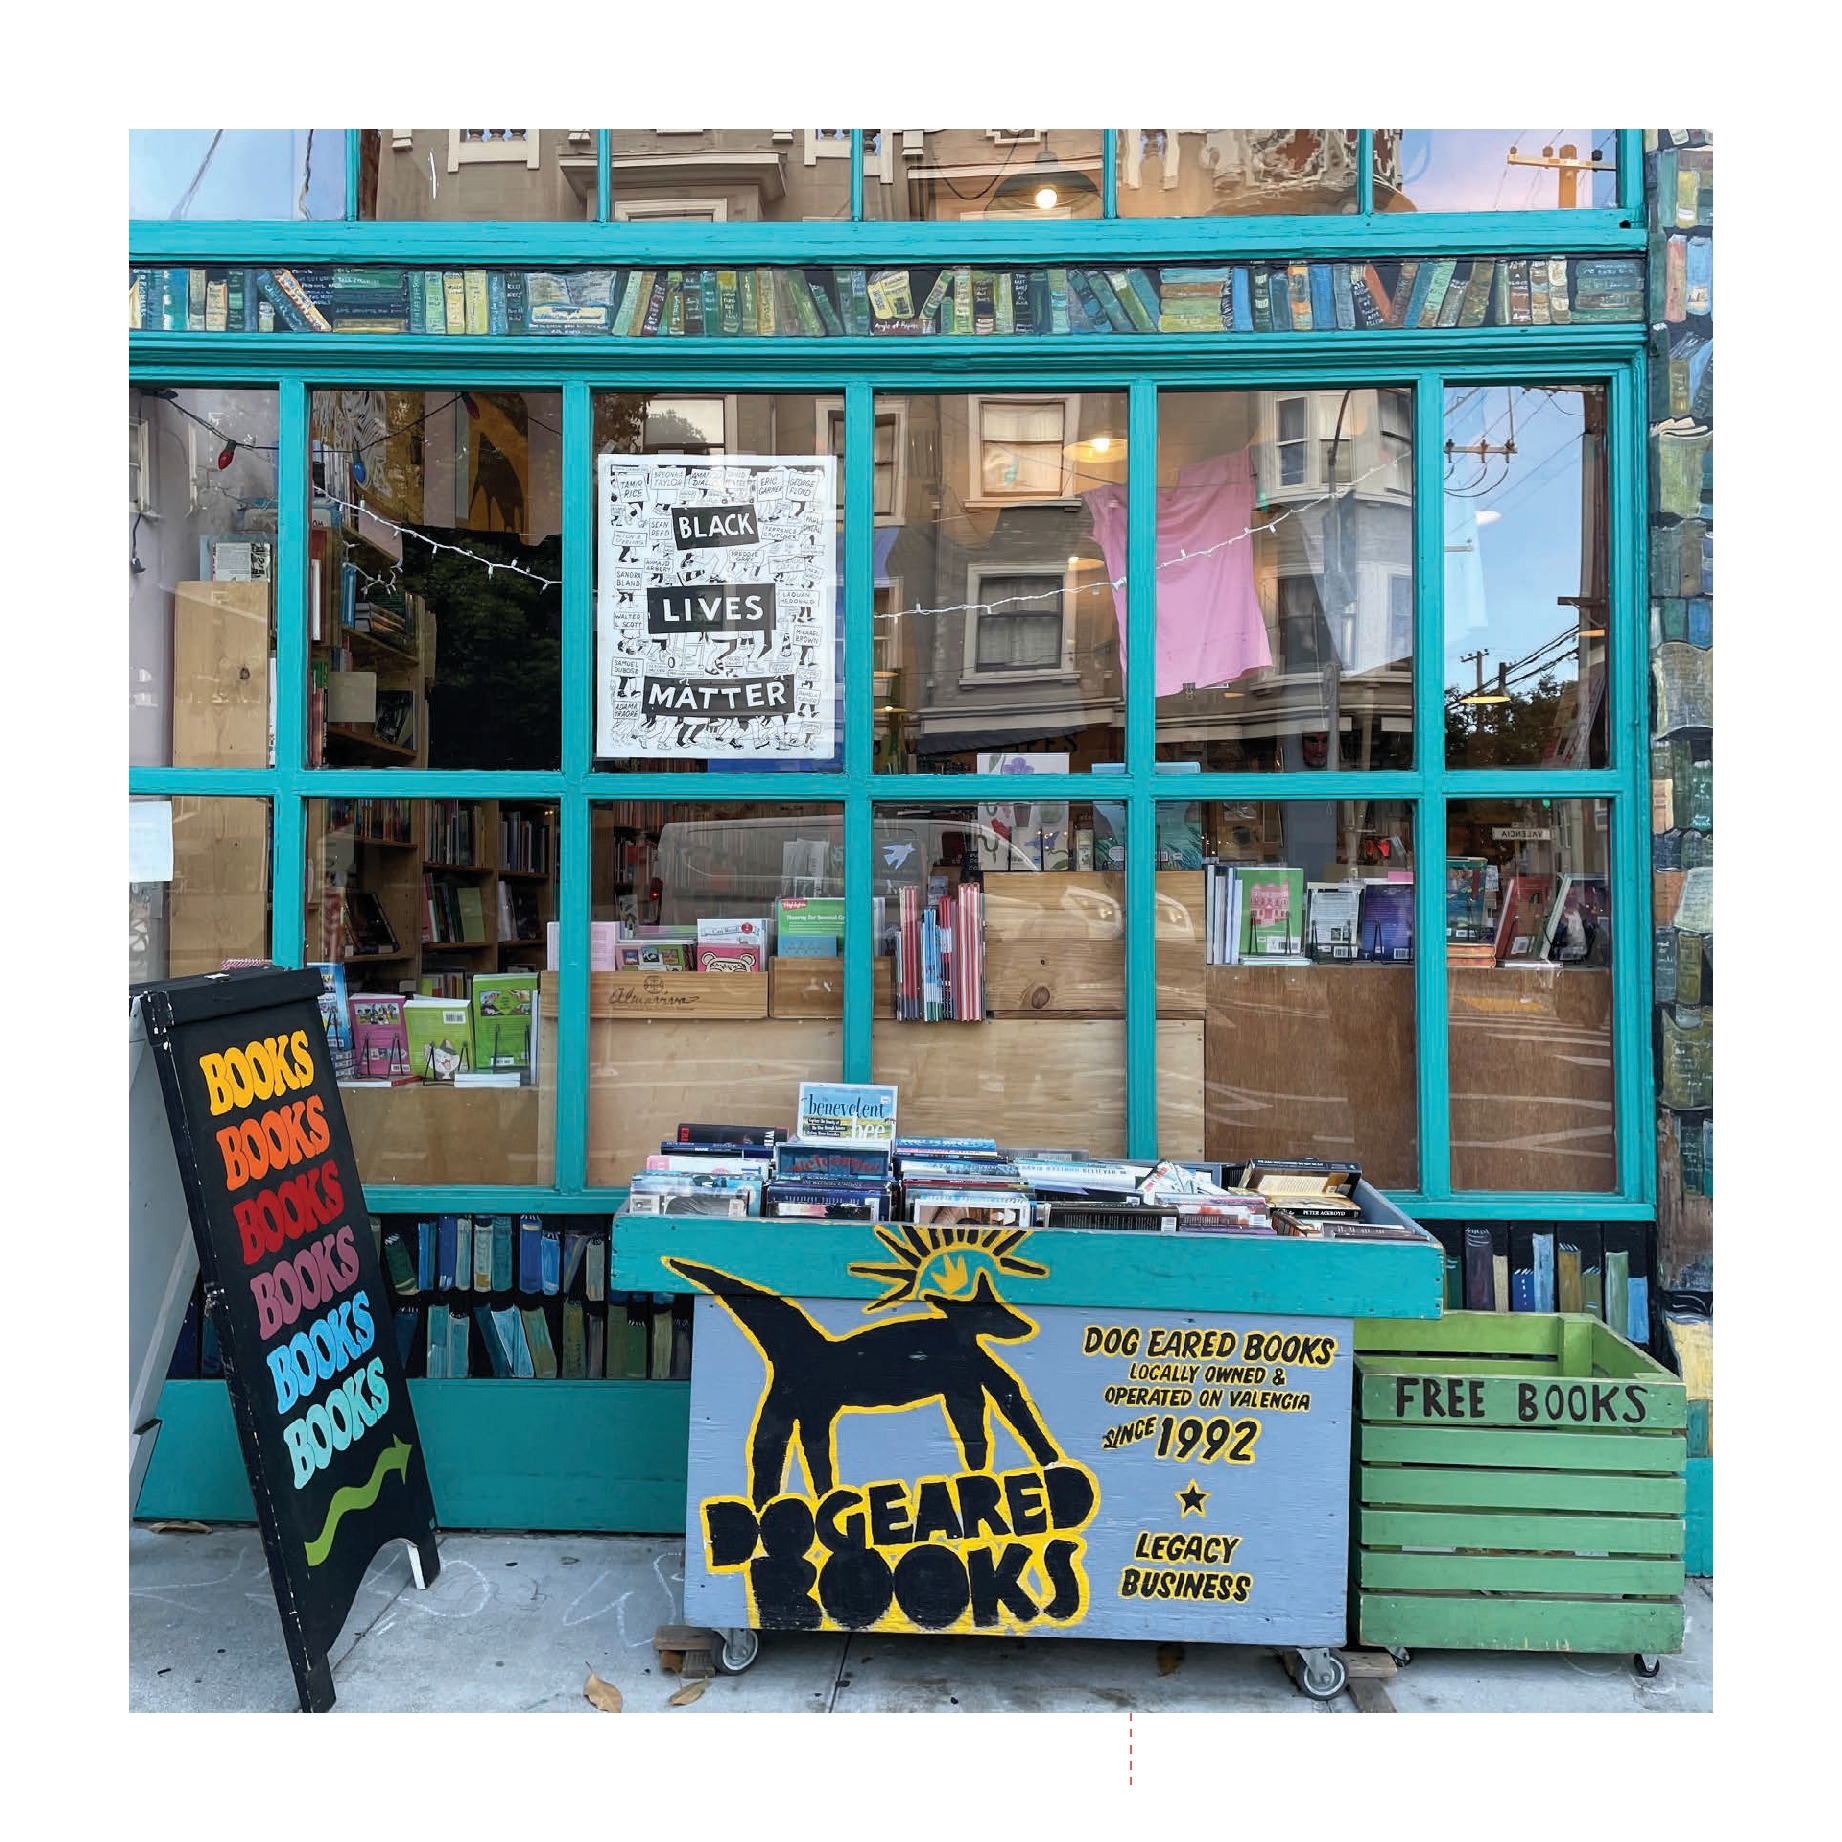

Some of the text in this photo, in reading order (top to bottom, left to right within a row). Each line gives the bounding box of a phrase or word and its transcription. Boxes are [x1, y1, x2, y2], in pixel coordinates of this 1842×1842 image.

[678, 512, 755, 539] BLACK
[662, 594, 764, 622] LIVES
[648, 681, 787, 710] MATTER
[200, 1030, 315, 1116] BOOKS
[808, 1093, 886, 1119] benevolent
[216, 1094, 331, 1191] BOOKS
[851, 1111, 886, 1140] bee
[233, 1159, 345, 1266] BOOKS
[1302, 1209, 1346, 1218] PETER ACKROYD
[250, 1225, 360, 1341] BOOKS
[266, 1290, 375, 1415] BOOKS
[1083, 1326, 1336, 1366] DOG EARED BOOKS
[1129, 1362, 1287, 1386] LOCALLY OWNED &
[1104, 1386, 1311, 1411] OPERATED ON VALENCIA
[1396, 1376, 1649, 1423] FREE BOOKS
[283, 1356, 390, 1490] BOOKS
[1102, 1415, 1258, 1462] SINCE 1992
[1135, 1532, 1240, 1564] LEGACY
[749, 1538, 1081, 1632] BOOKS
[1121, 1567, 1252, 1603] BUSINESS
